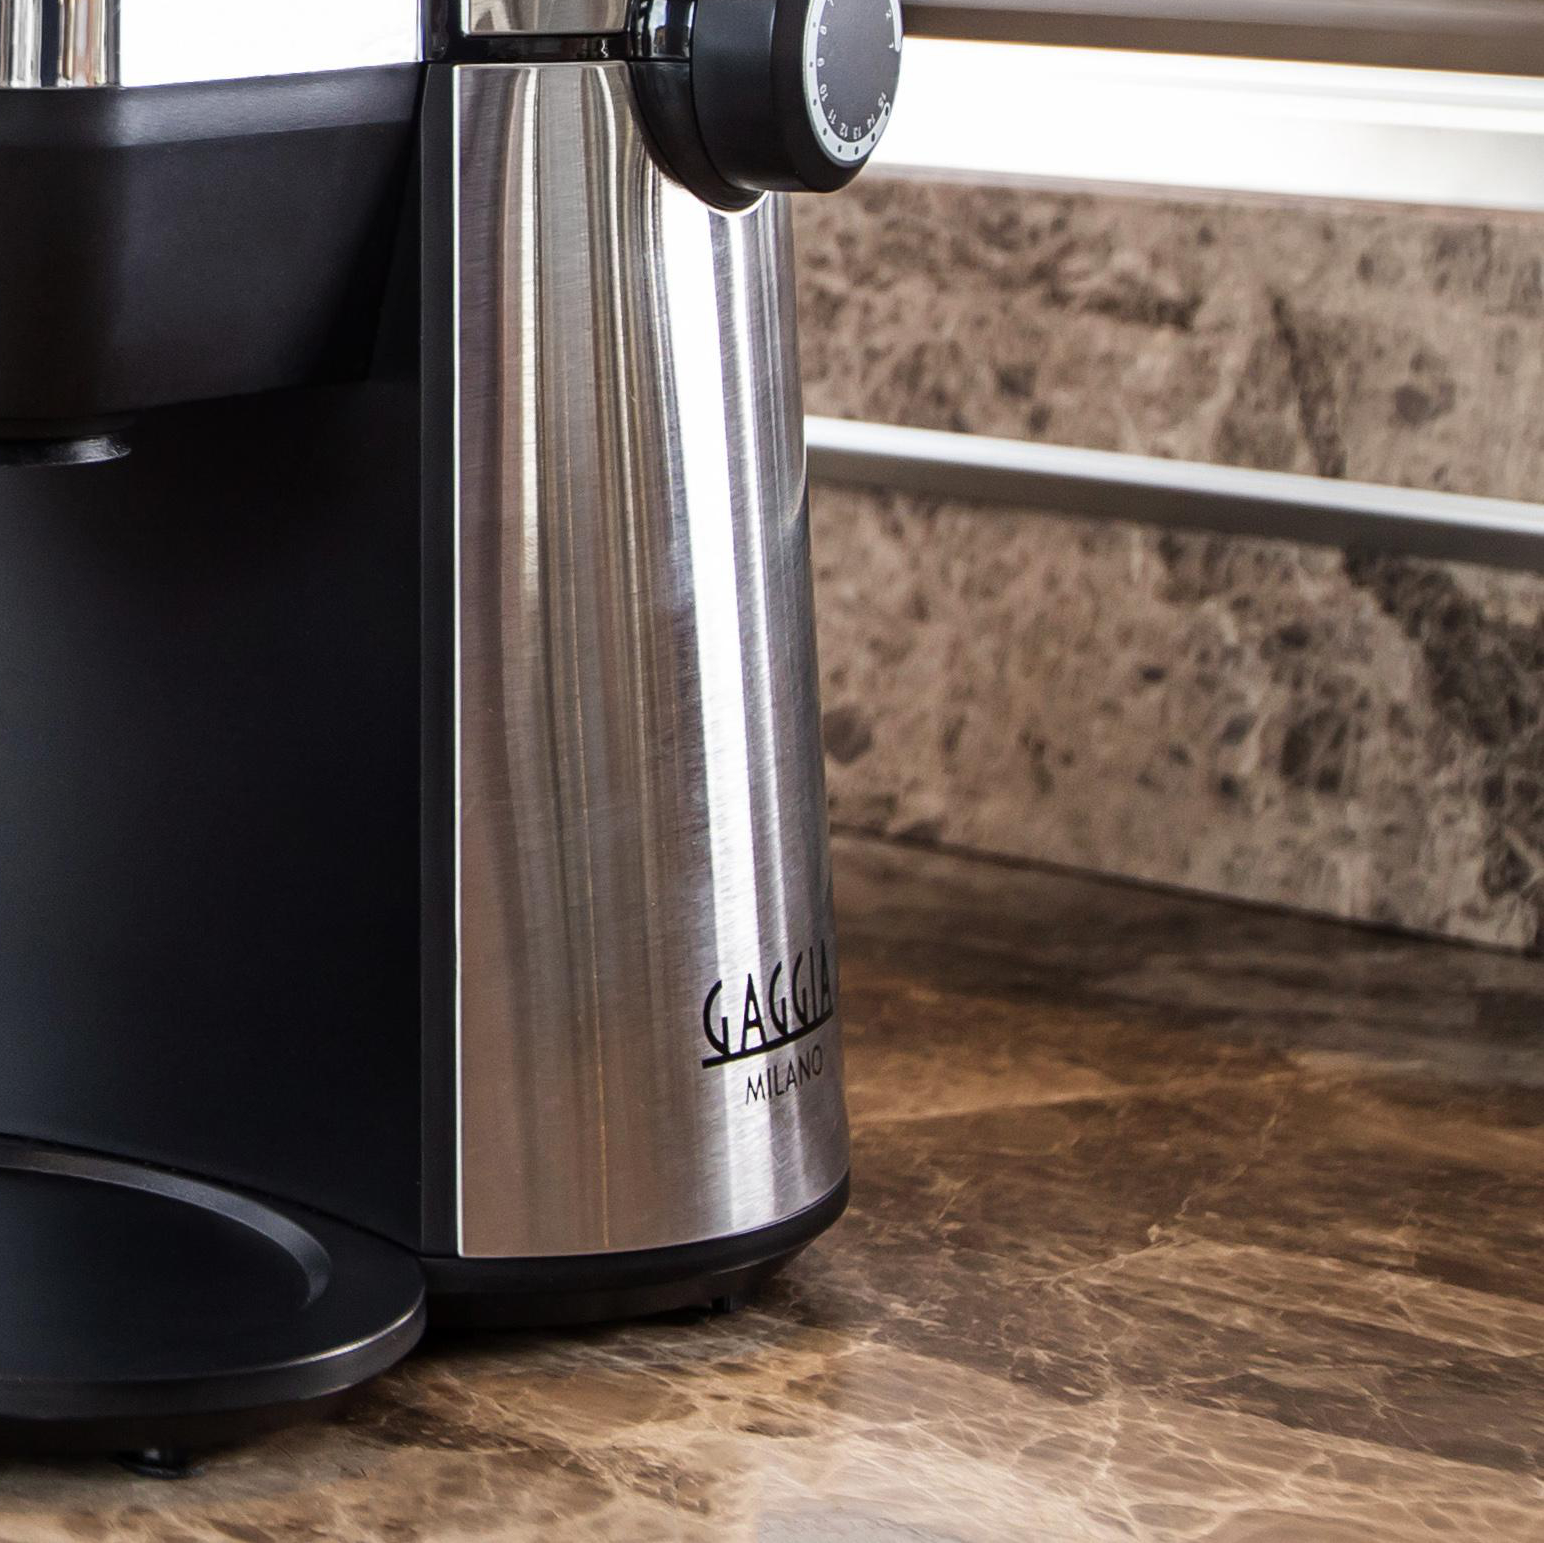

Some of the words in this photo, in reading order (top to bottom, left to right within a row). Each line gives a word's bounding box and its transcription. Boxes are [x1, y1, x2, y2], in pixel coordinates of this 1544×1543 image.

[819, 83, 829, 102] 10
[828, 108, 837, 125] 11
[839, 122, 849, 138] 12
[702, 939, 834, 1060] GAGGIA
[745, 1043, 824, 1106] MILANO
